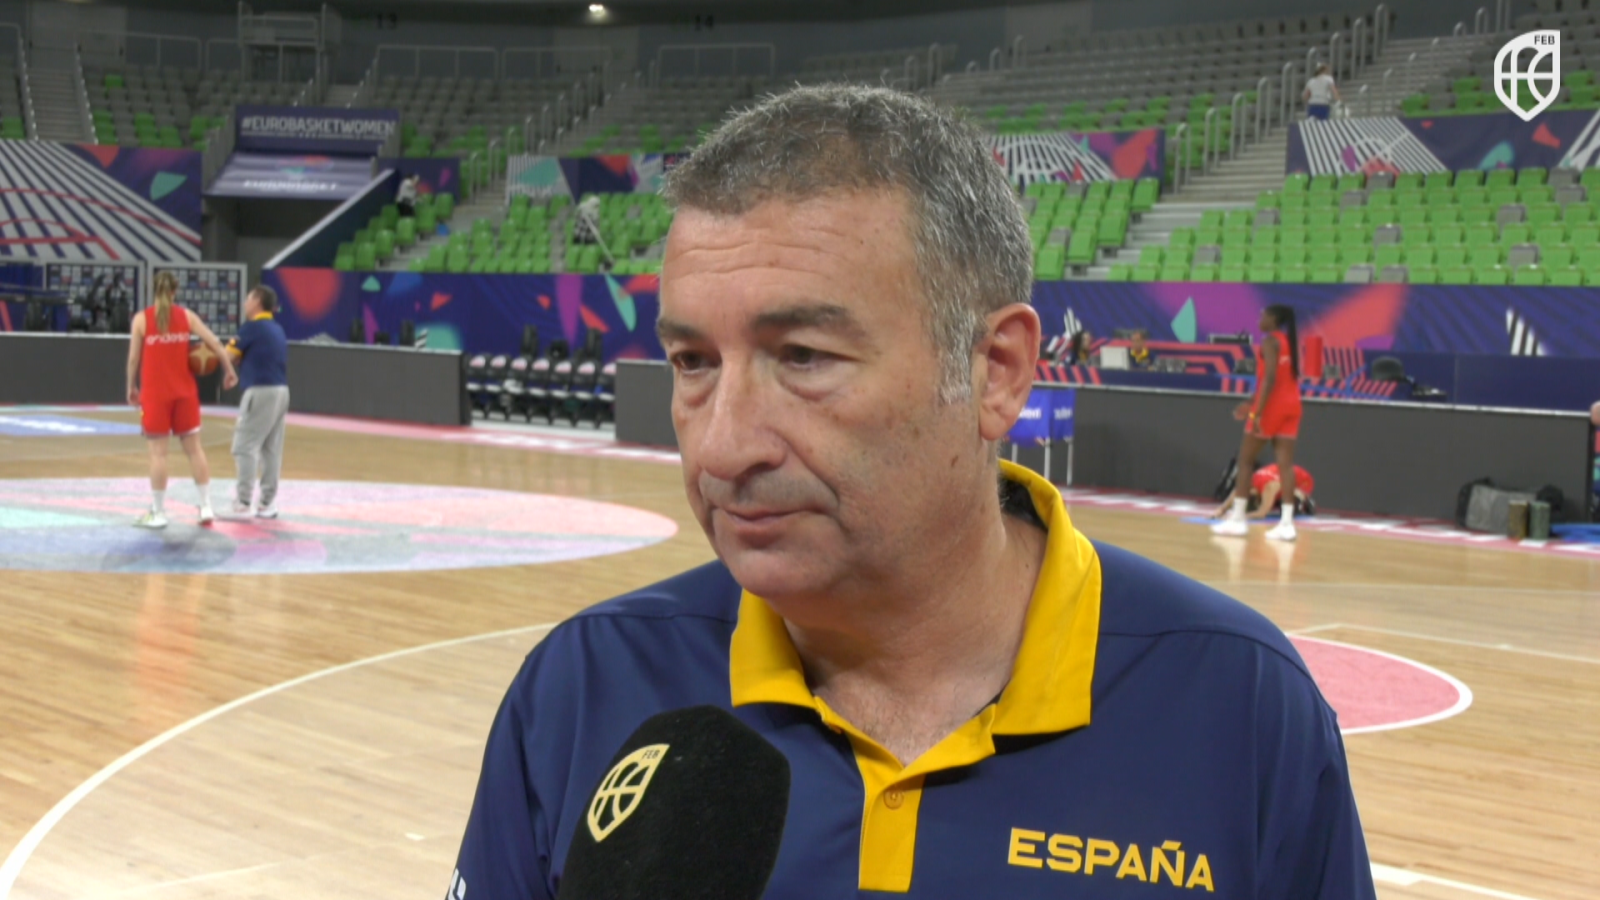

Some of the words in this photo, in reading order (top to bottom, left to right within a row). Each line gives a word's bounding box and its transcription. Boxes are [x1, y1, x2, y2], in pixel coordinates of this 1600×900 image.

[241, 115, 396, 135] #EUROBASKETWOMEN
[641, 749, 660, 759] FEB
[1007, 826, 1214, 892] ESPAÑA
